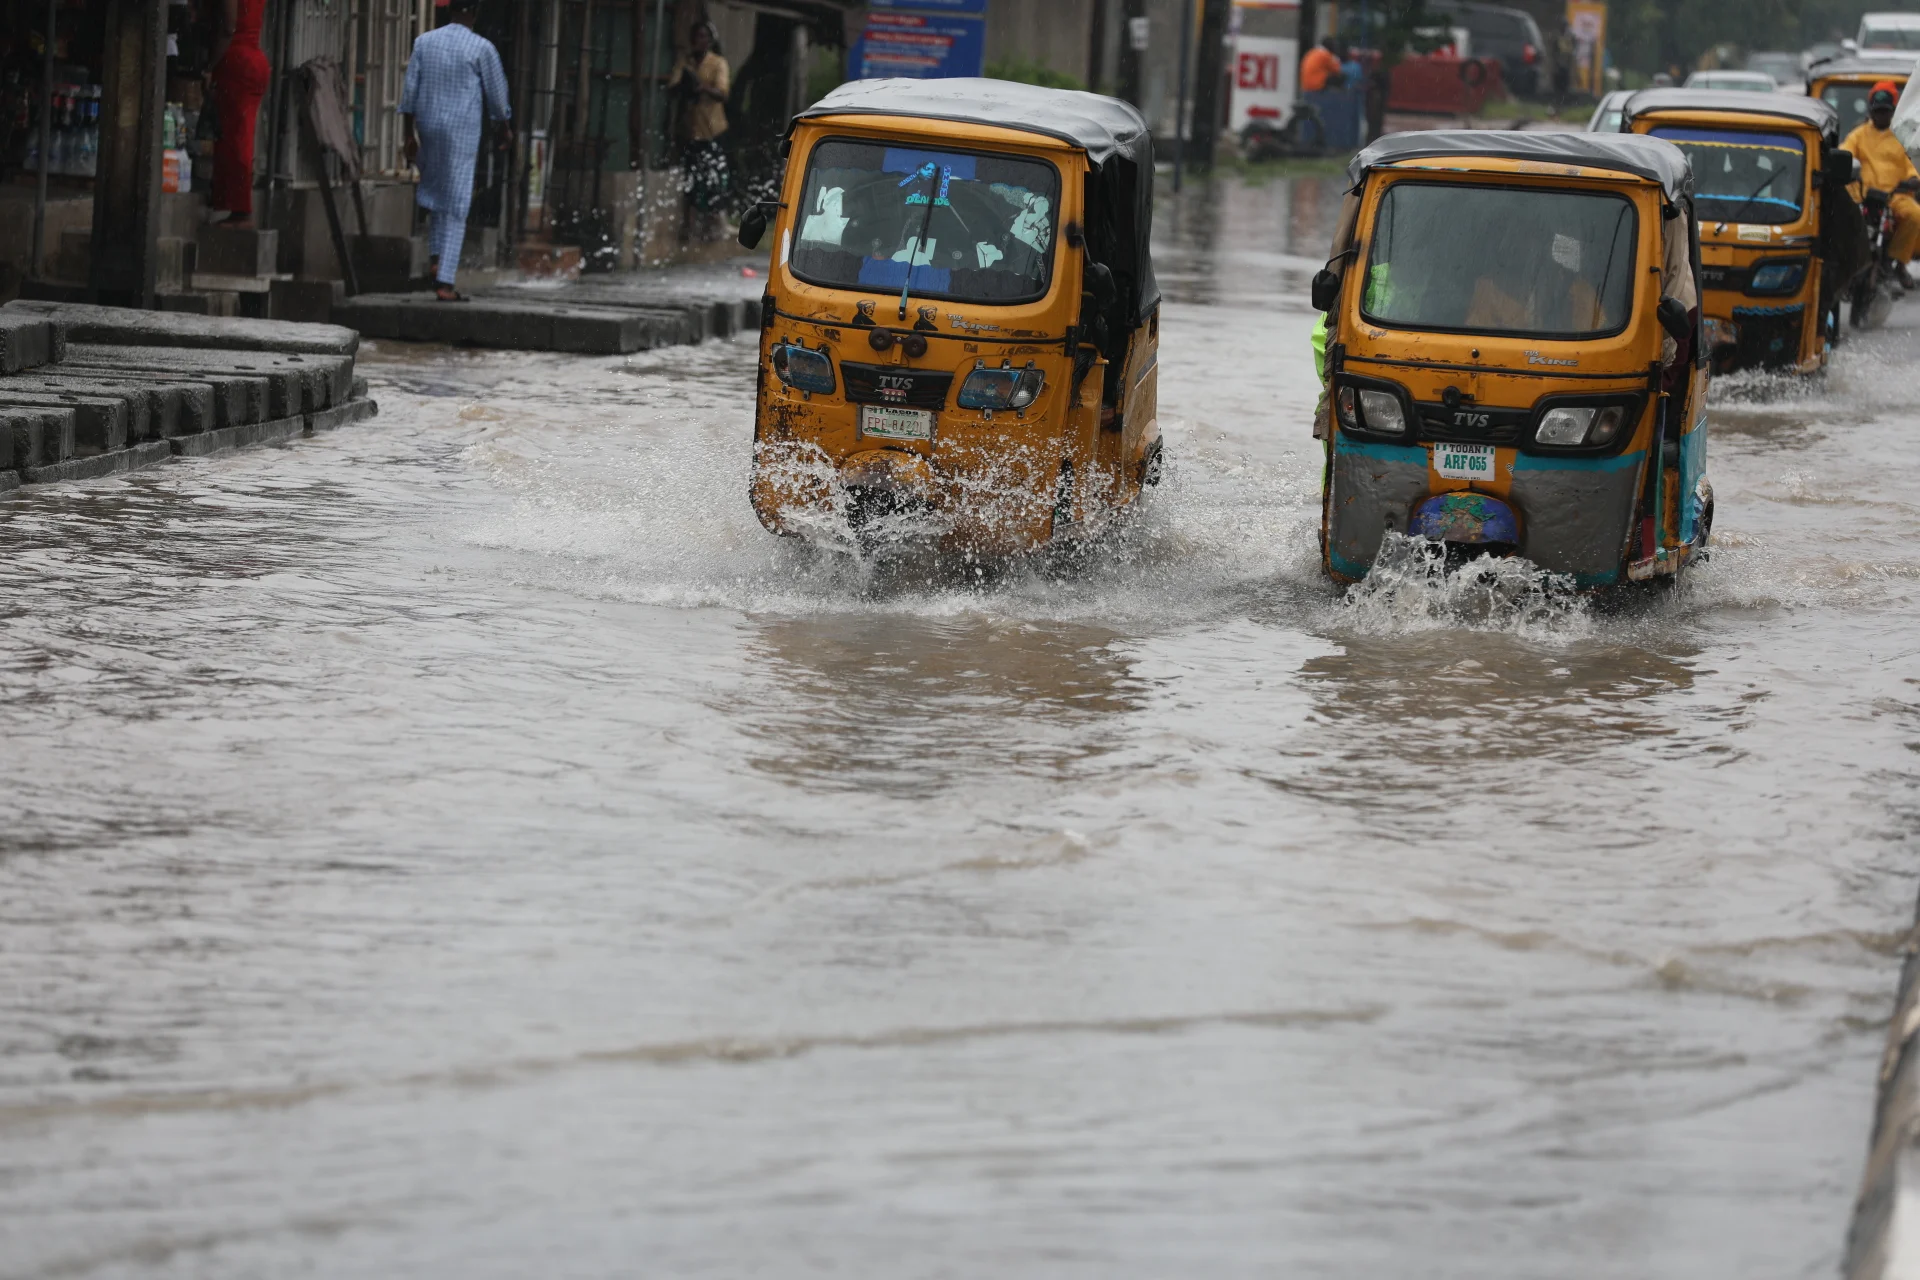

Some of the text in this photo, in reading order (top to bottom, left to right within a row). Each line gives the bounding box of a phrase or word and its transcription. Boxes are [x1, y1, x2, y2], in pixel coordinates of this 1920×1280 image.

[951, 320, 1000, 331] KING
[1528, 356, 1578, 367] KING
[878, 375, 914, 390] TVS
[885, 408, 919, 416] LAGOS
[1453, 412, 1489, 428] TVS
[1449, 444, 1481, 454] TOOAN
[1443, 454, 1487, 471] ARF 055
